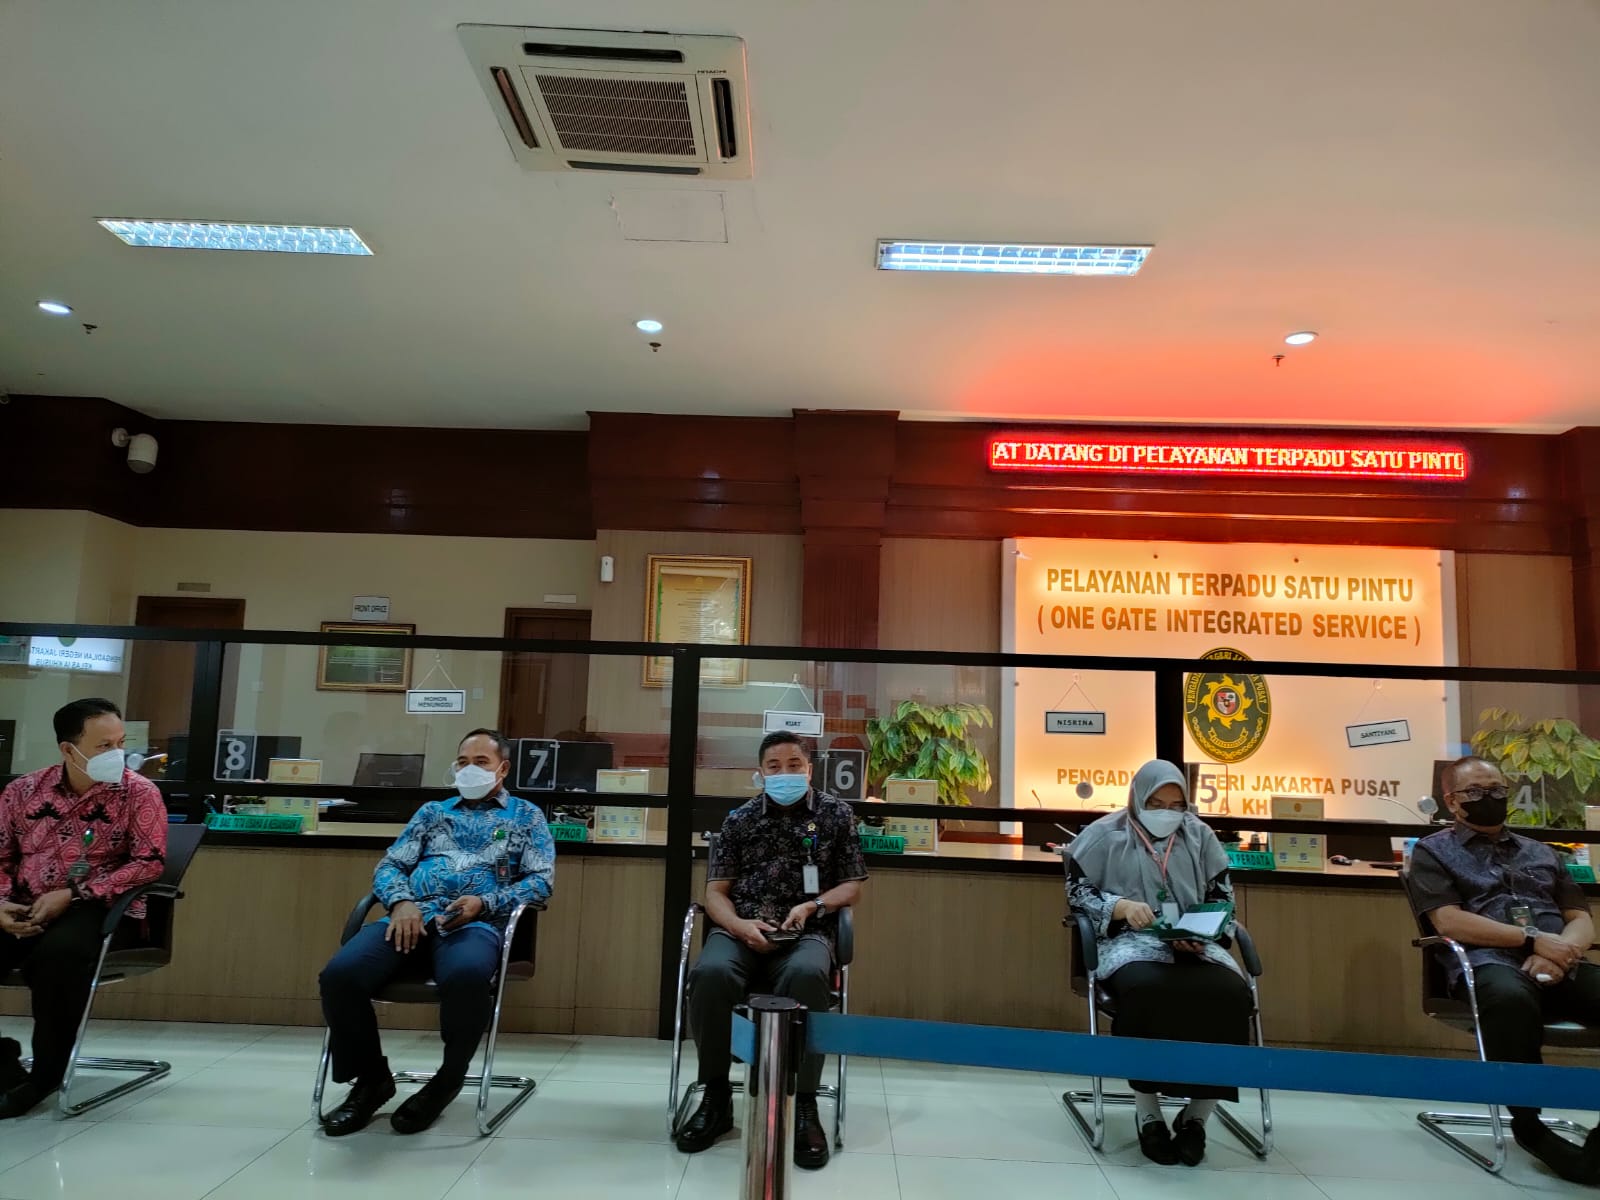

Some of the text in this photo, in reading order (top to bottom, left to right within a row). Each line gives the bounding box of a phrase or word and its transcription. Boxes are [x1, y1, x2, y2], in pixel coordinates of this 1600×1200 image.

[1026, 443, 1104, 462] DATANG
[1109, 445, 1128, 463] DI
[1133, 446, 1248, 465] PELAYANAN
[1254, 448, 1346, 468] TERPADU
[1351, 450, 1403, 469] SATU
[1047, 568, 1413, 602] PELAYANAN TERPADU SATU PINTU
[1050, 605, 1095, 630] ONE
[1101, 606, 1157, 632] GATE
[1166, 608, 1303, 636] INTEGRATED
[1312, 613, 1408, 640] SERVICE
[225, 740, 247, 771] 8
[528, 749, 549, 787] 7
[834, 760, 856, 790] 6
[1199, 773, 1218, 804] 5
[1251, 775, 1336, 795] JAKARTA
[1341, 778, 1401, 798] PUSAT
[1514, 784, 1537, 816] 4
[871, 838, 899, 850] PIDANA
[1236, 853, 1271, 866] PERDATA
